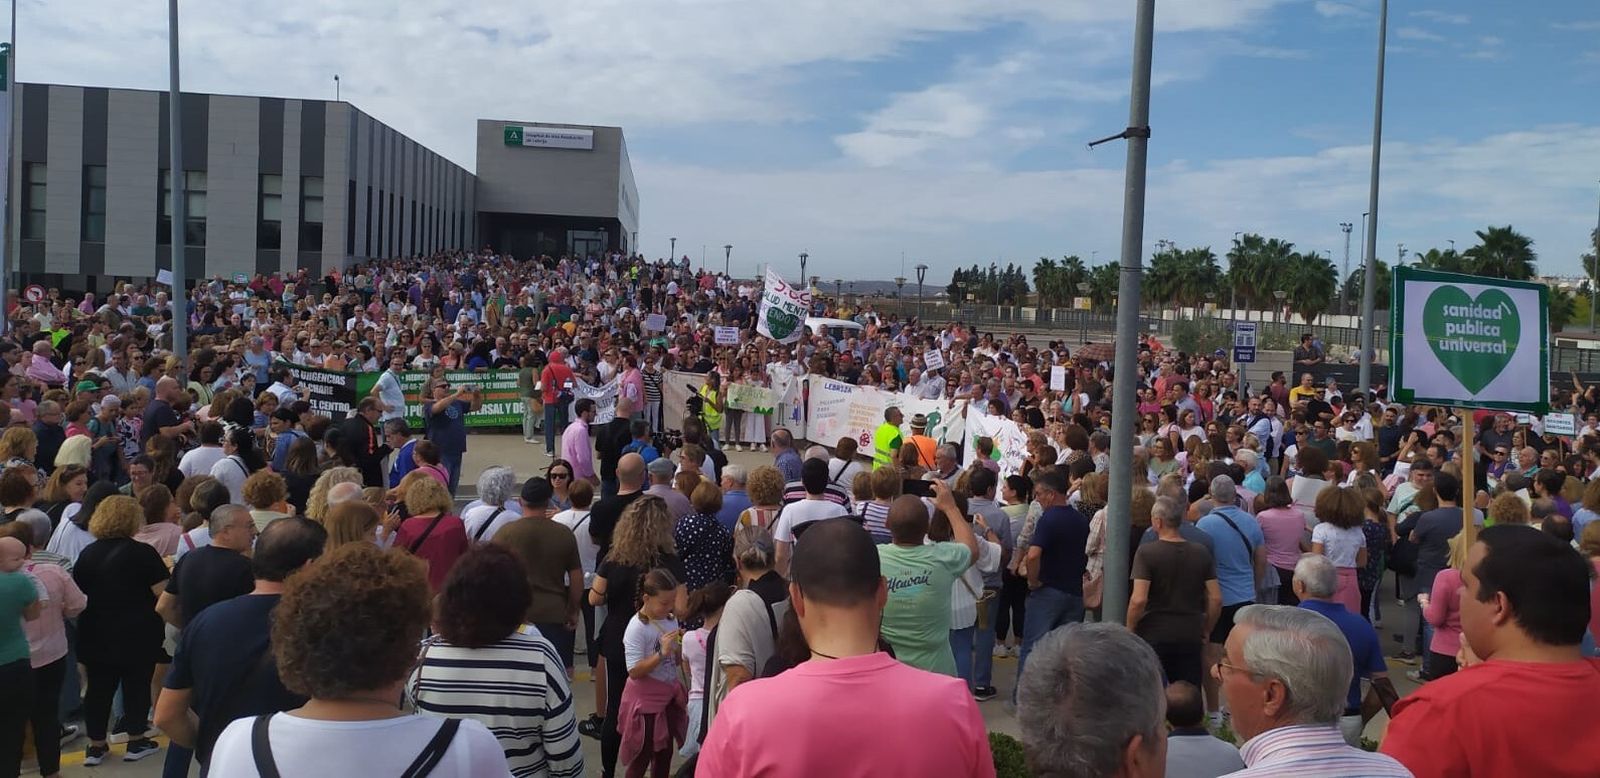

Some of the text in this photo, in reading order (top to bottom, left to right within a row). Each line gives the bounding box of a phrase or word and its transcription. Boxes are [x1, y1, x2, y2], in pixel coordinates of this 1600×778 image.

[1443, 303, 1502, 319] sanidad
[1445, 319, 1501, 336] publica
[1440, 337, 1506, 354] universal
[318, 400, 350, 412] CENTRO
